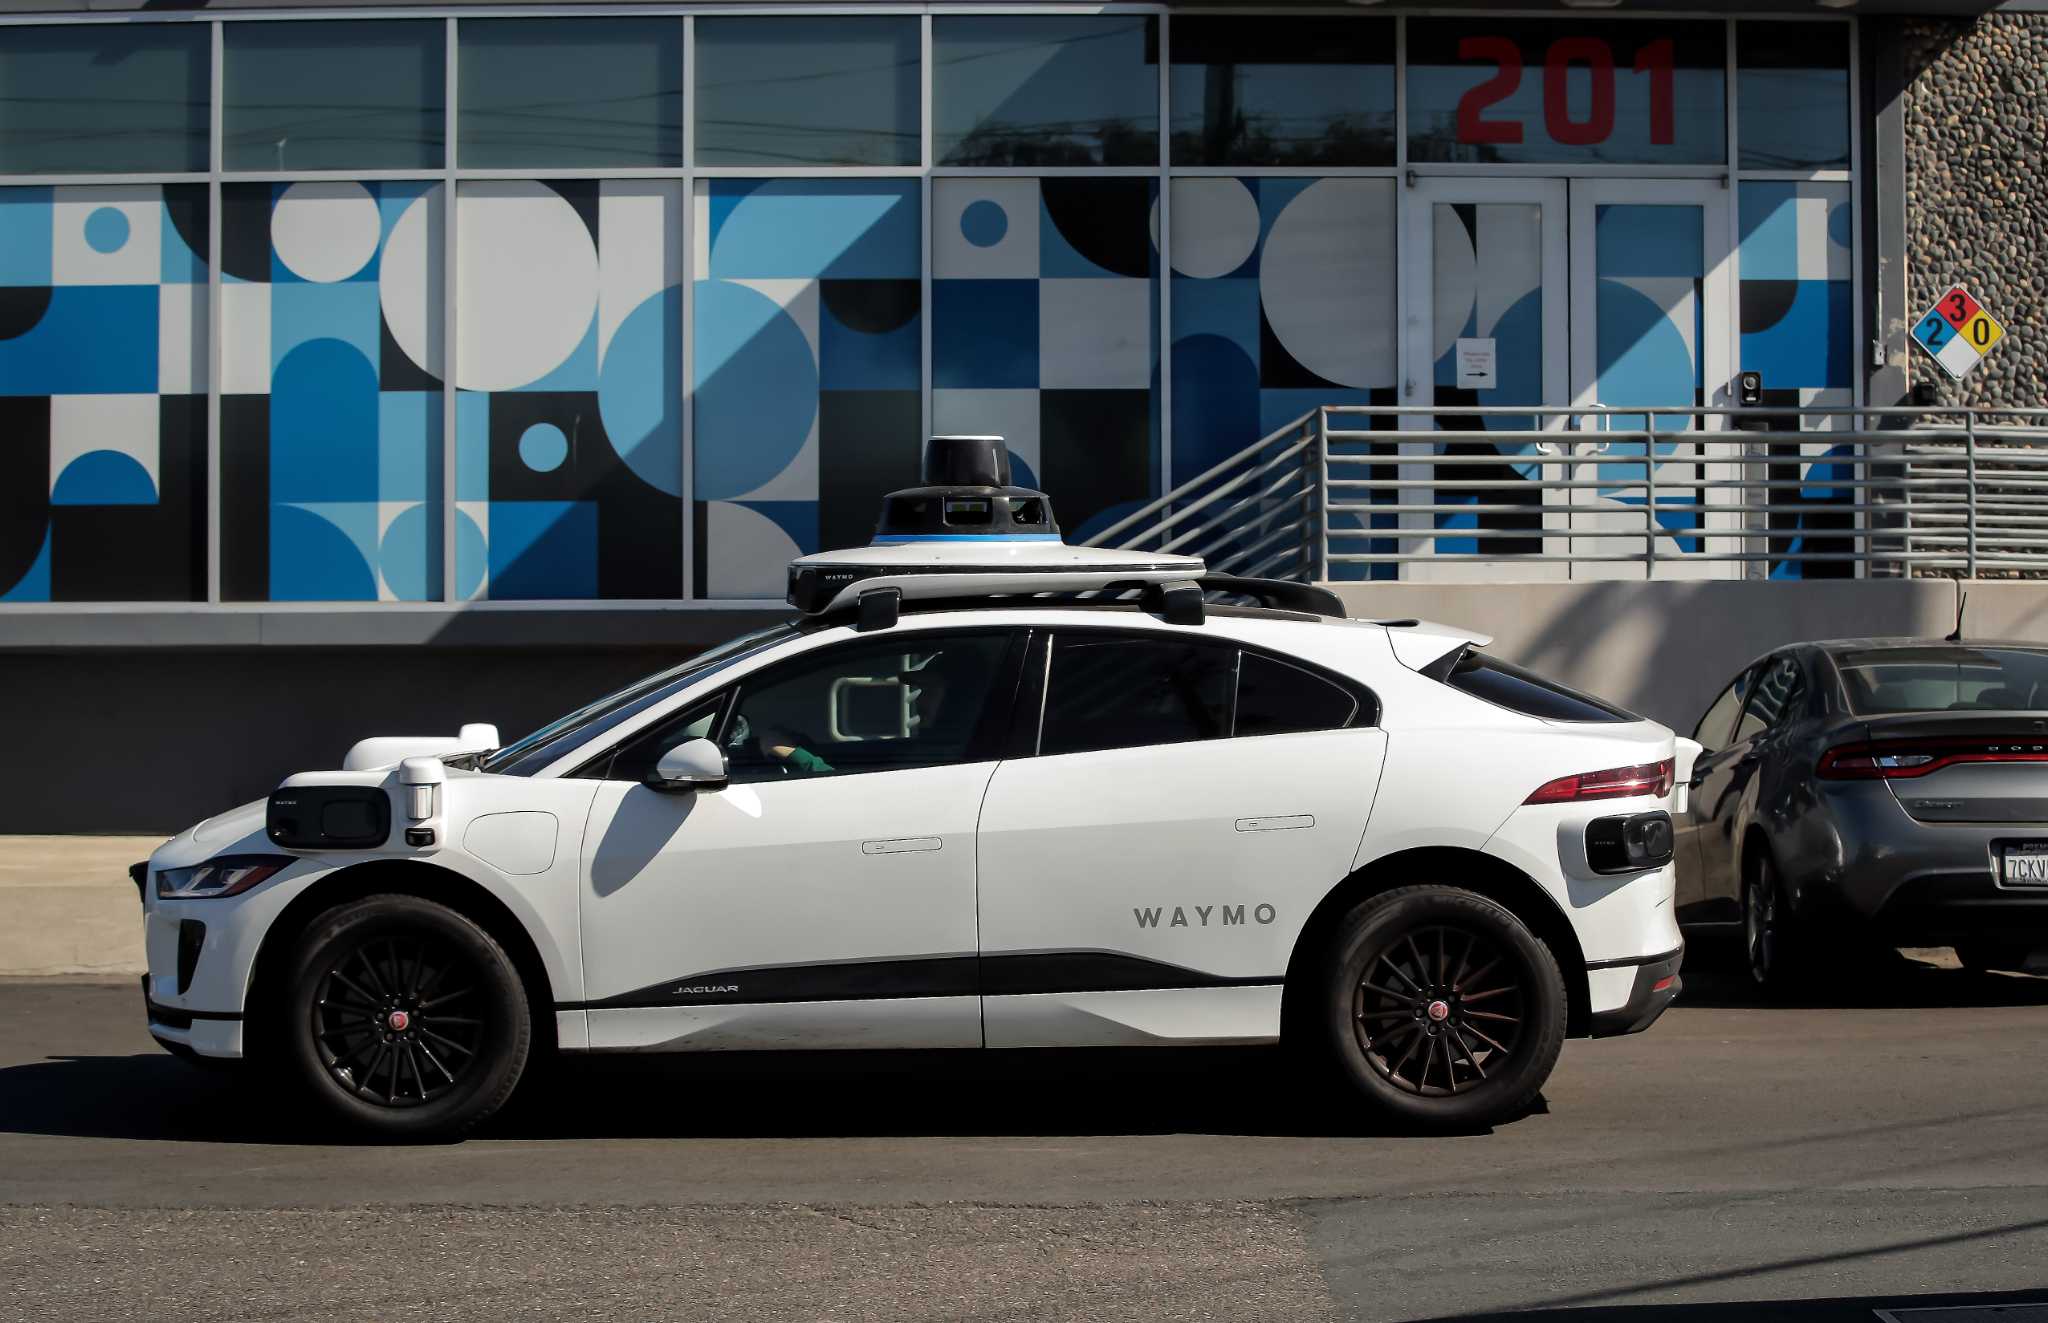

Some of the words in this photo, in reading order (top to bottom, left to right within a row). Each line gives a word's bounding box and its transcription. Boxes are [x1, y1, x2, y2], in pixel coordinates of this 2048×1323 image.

[1456, 37, 1674, 144] 201
[1949, 294, 1966, 322] 3
[1926, 317, 1943, 345] 2
[1973, 318, 1990, 346] 0
[1133, 903, 1276, 928] WAYMO
[672, 985, 739, 994] JAGUAR
